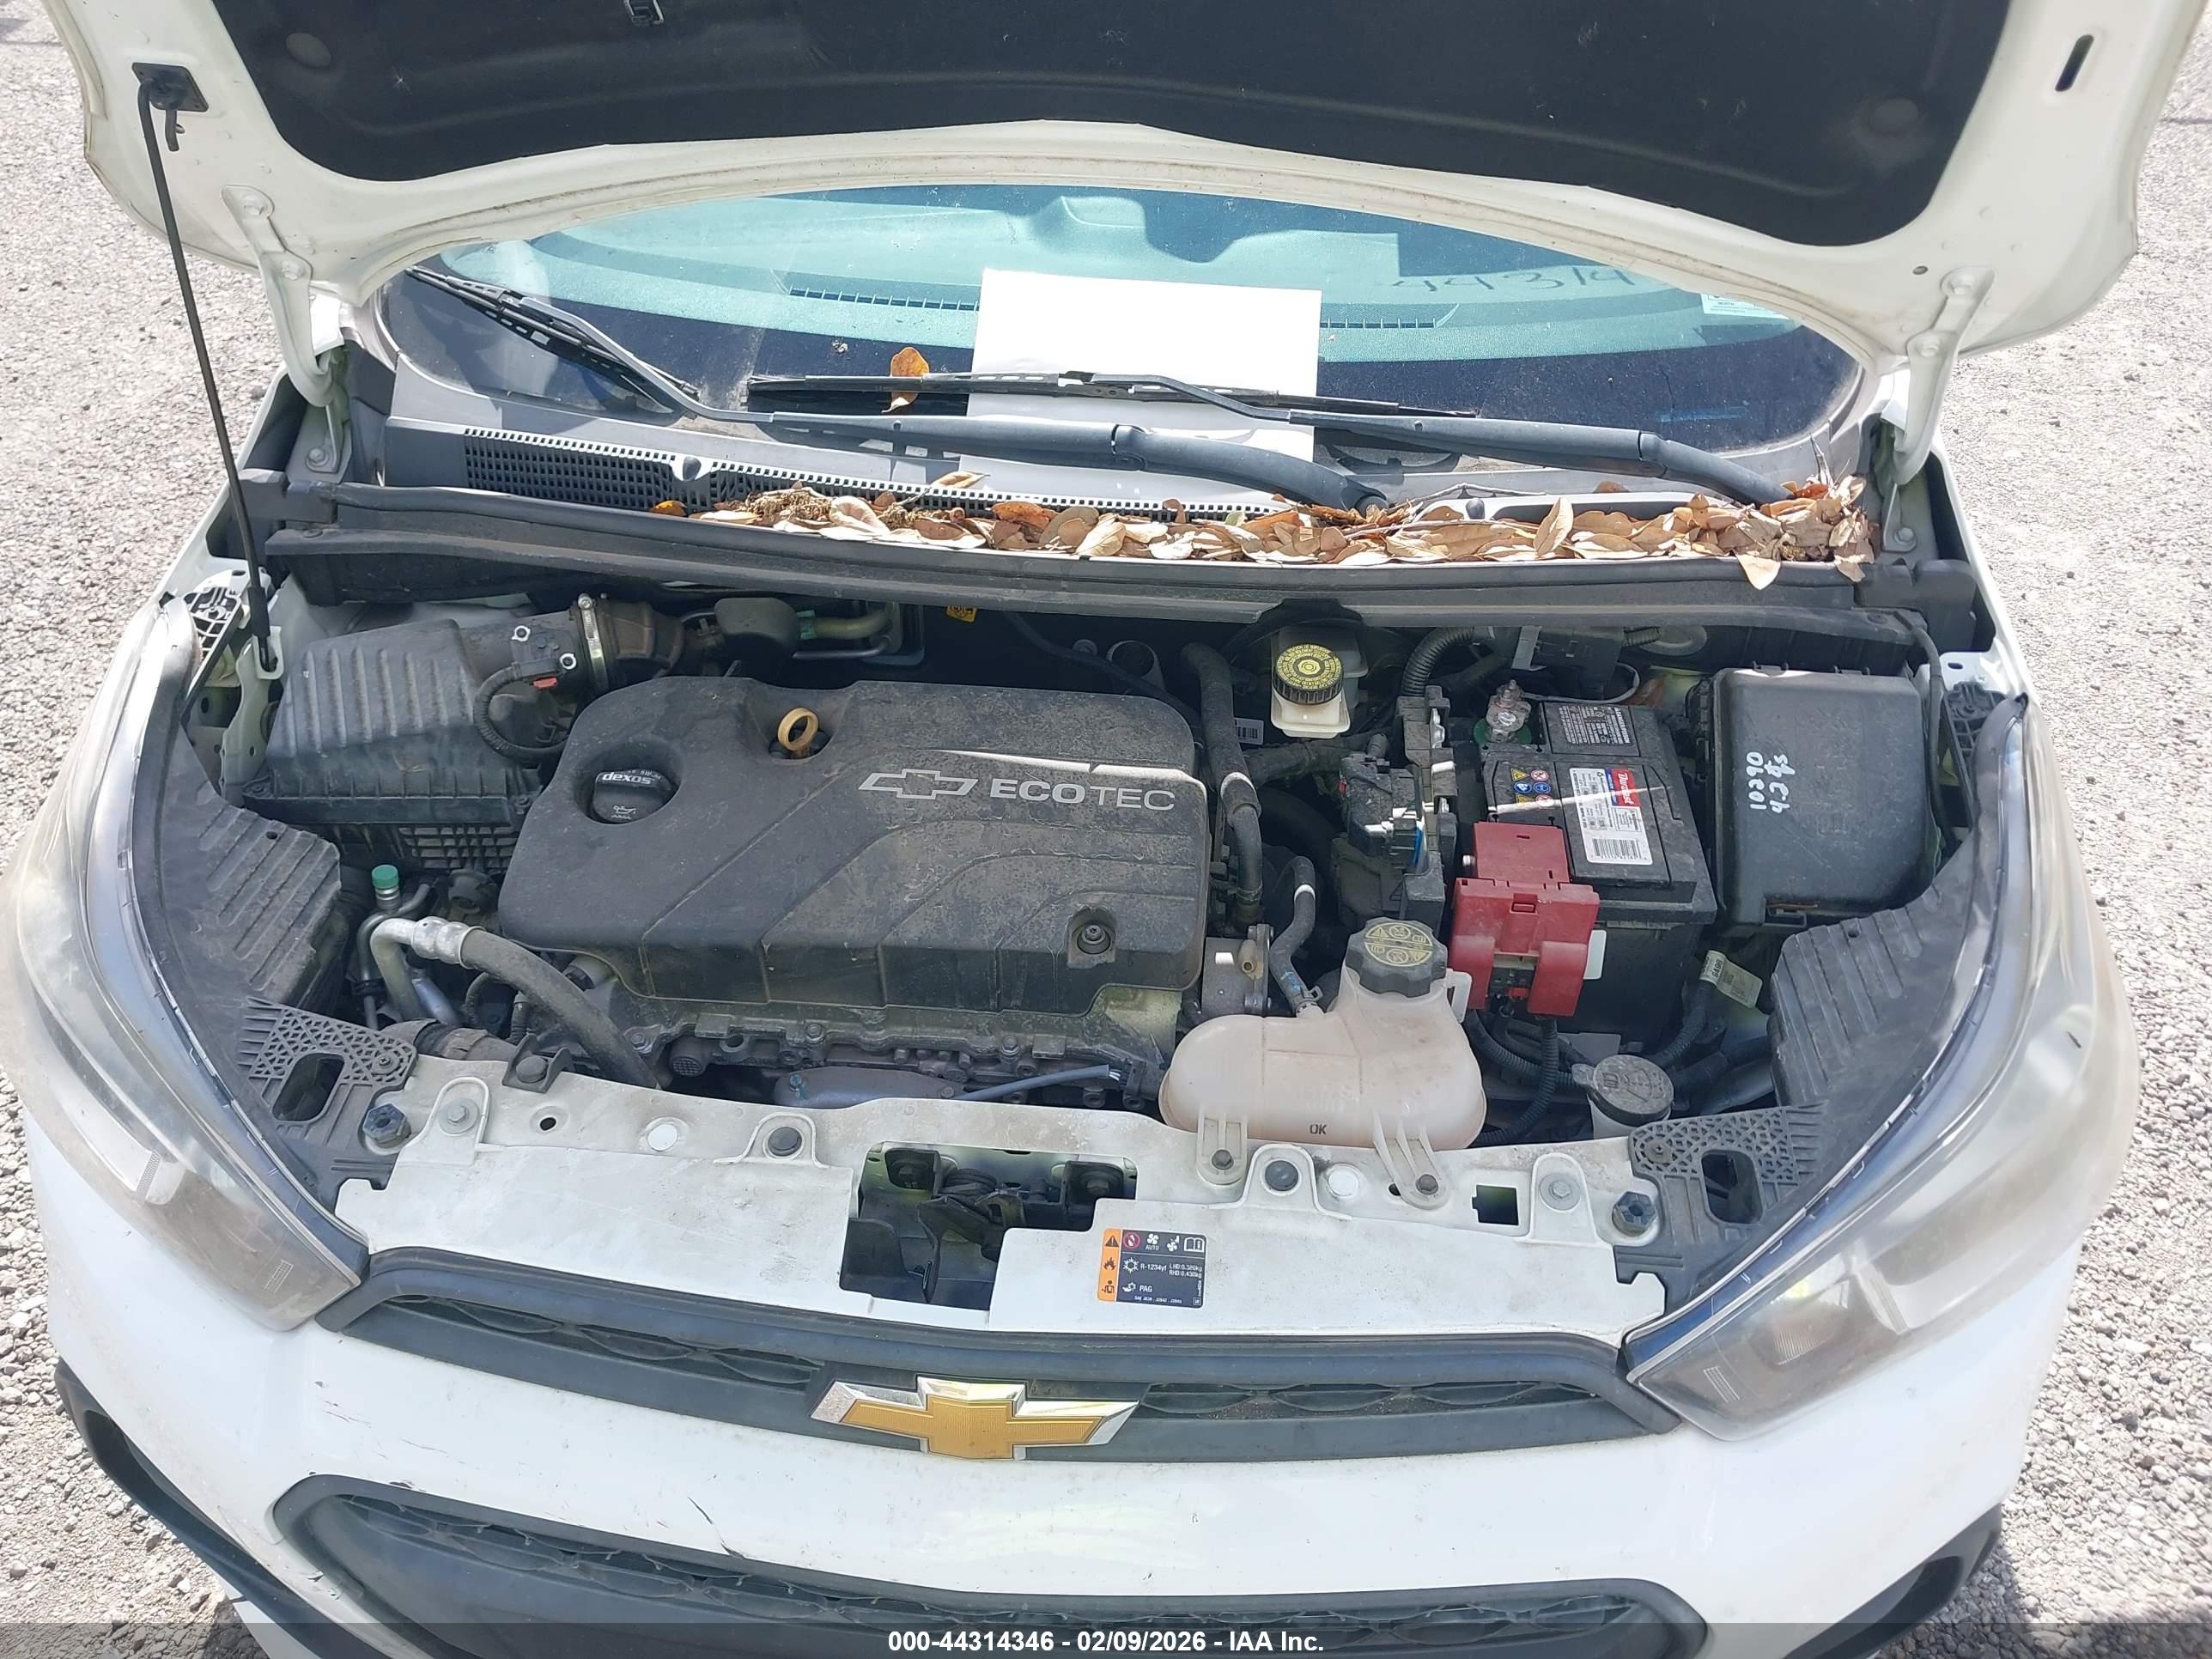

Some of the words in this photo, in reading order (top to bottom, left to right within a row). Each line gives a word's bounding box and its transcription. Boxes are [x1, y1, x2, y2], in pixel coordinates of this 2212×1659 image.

[602, 772, 652, 785] dexos
[989, 778, 1176, 811] ECOTEC
[1618, 773, 1635, 805] Duraast
[1310, 1123, 1328, 1135] OK
[1140, 1263, 1167, 1272] R-1234yf
